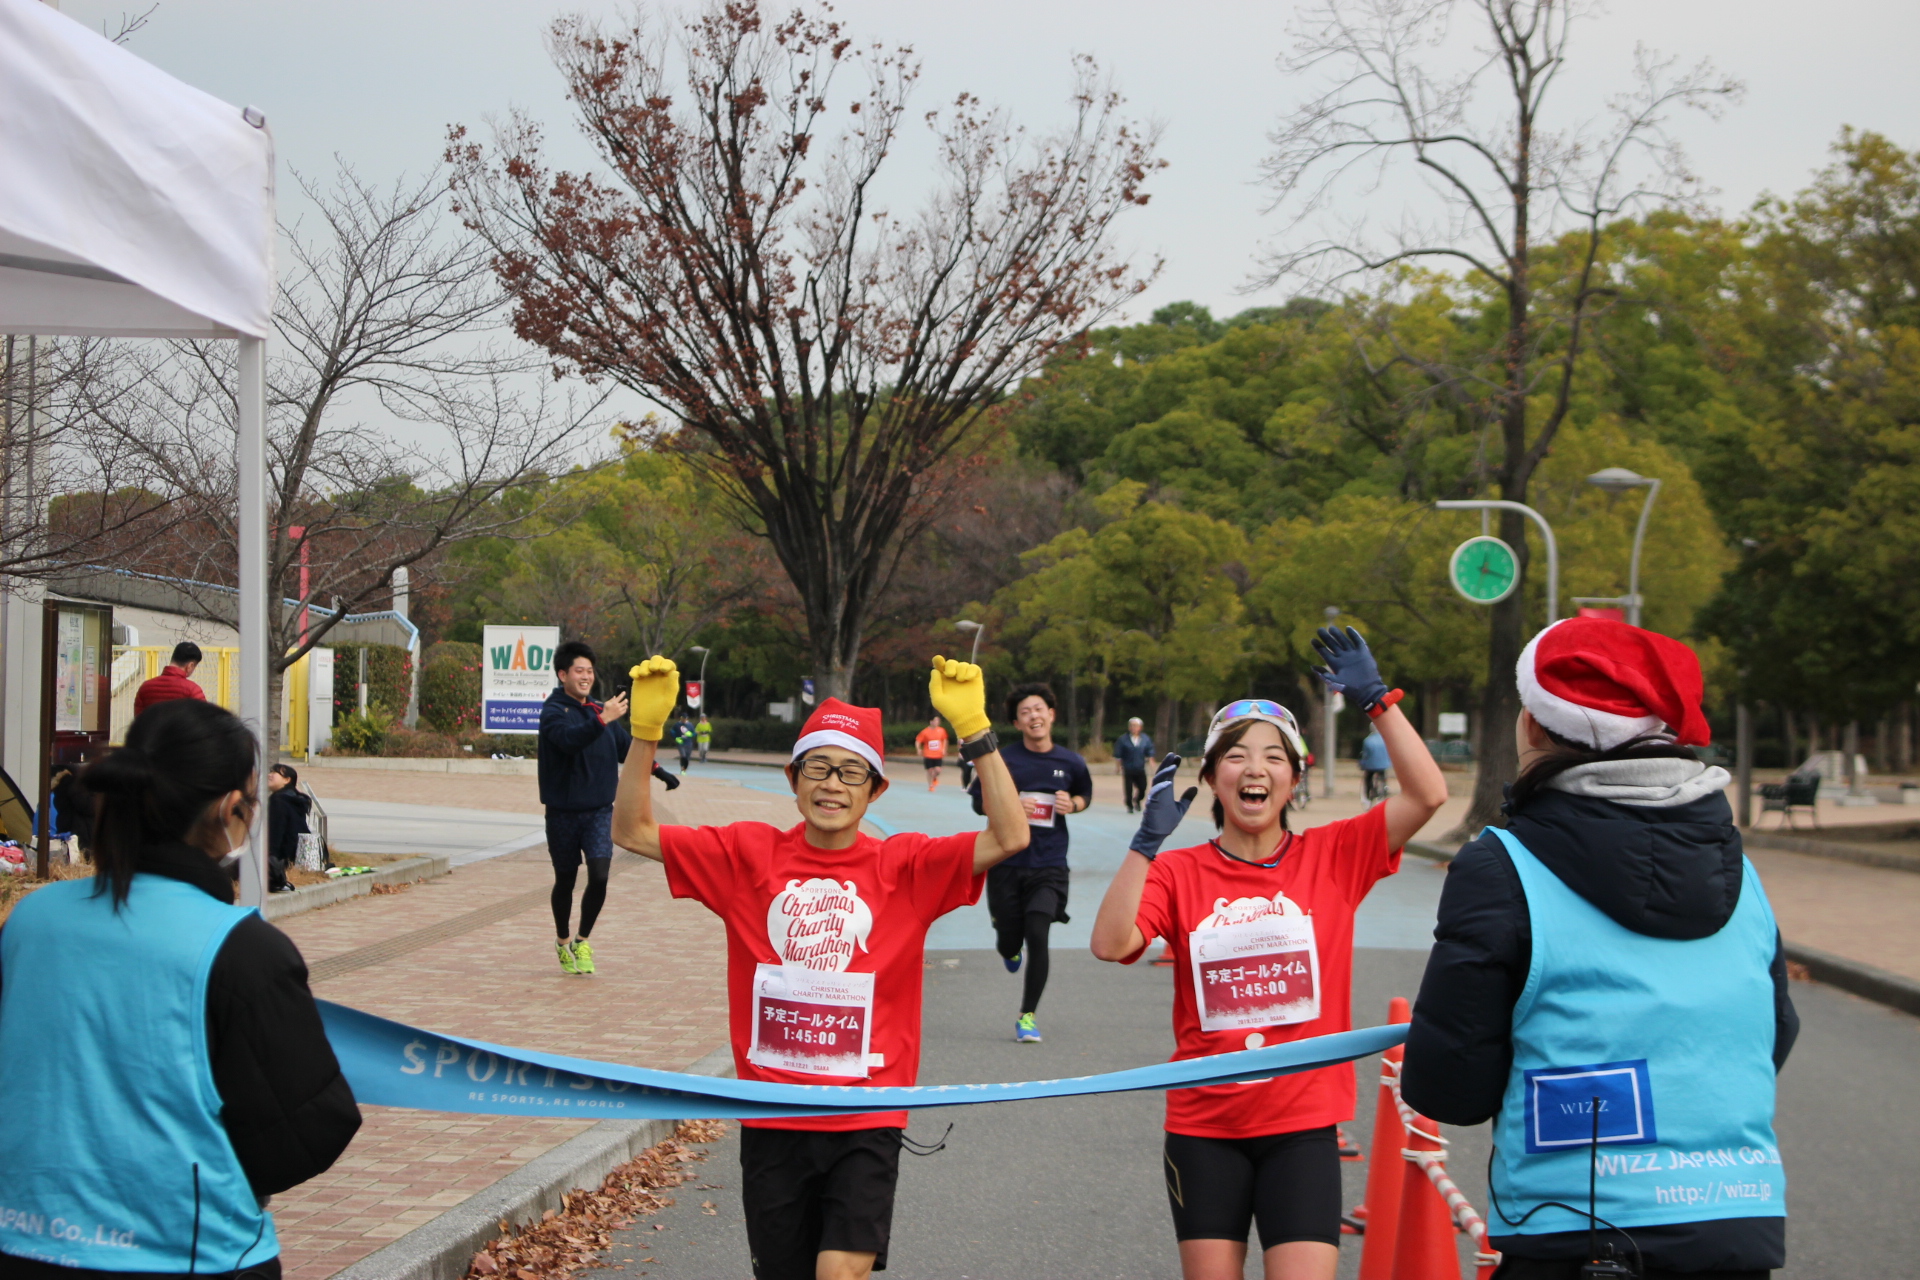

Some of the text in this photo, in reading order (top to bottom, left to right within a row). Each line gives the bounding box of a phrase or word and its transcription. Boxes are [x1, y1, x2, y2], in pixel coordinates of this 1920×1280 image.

[490, 633, 553, 671] WAO!
[800, 886, 842, 895] SPORTSONE
[781, 893, 854, 917] Christmas
[786, 912, 845, 938] Charity
[782, 934, 851, 962] Marathon
[1232, 938, 1308, 953] CHARITY MARATHON
[1250, 934, 1290, 944] CHRISTMAS
[1205, 960, 1308, 985] 予定ゴールタイム
[792, 989, 866, 1001] CHARITY MARATHON
[810, 985, 849, 994] CHRISTMAS
[1230, 979, 1288, 999] 1:45:00
[763, 1006, 859, 1030] 予定ゴールタイム
[783, 1026, 837, 1046] 1:45:00
[468, 1091, 485, 1101] RE
[576, 1099, 626, 1108] WORLD
[1560, 1100, 1609, 1115] WIZZ
[1594, 1152, 1662, 1177] WIZZ
[1668, 1147, 1738, 1170] JAPAN
[1655, 1179, 1772, 1205] http://wizz.jp
